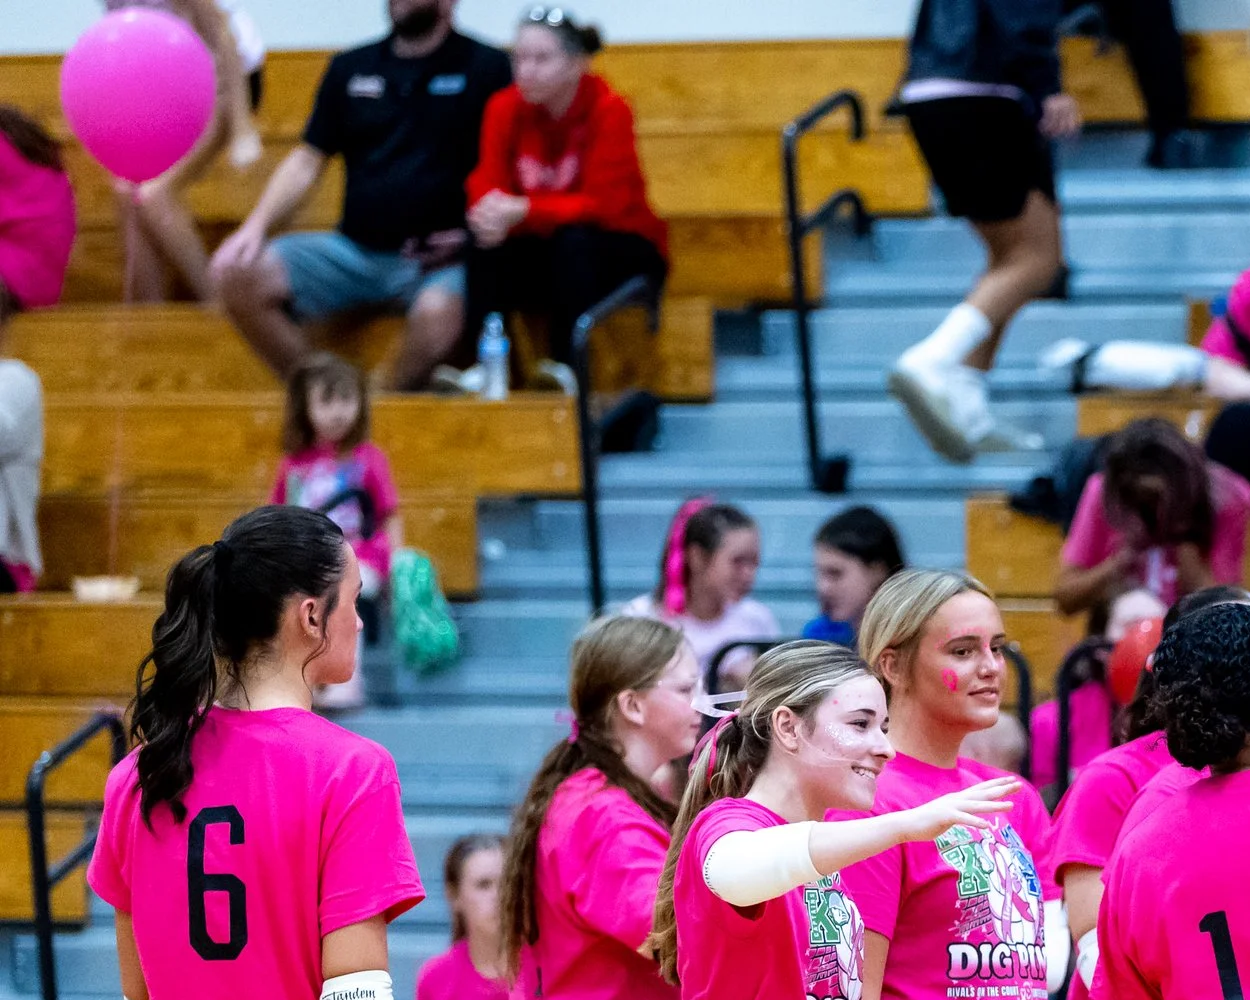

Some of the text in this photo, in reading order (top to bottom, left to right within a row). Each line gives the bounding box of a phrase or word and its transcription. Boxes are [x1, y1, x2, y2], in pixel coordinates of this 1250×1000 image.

[187, 805, 248, 960] 6
[947, 942, 1048, 981] DIG PIN
[947, 984, 975, 997] RIVALS
